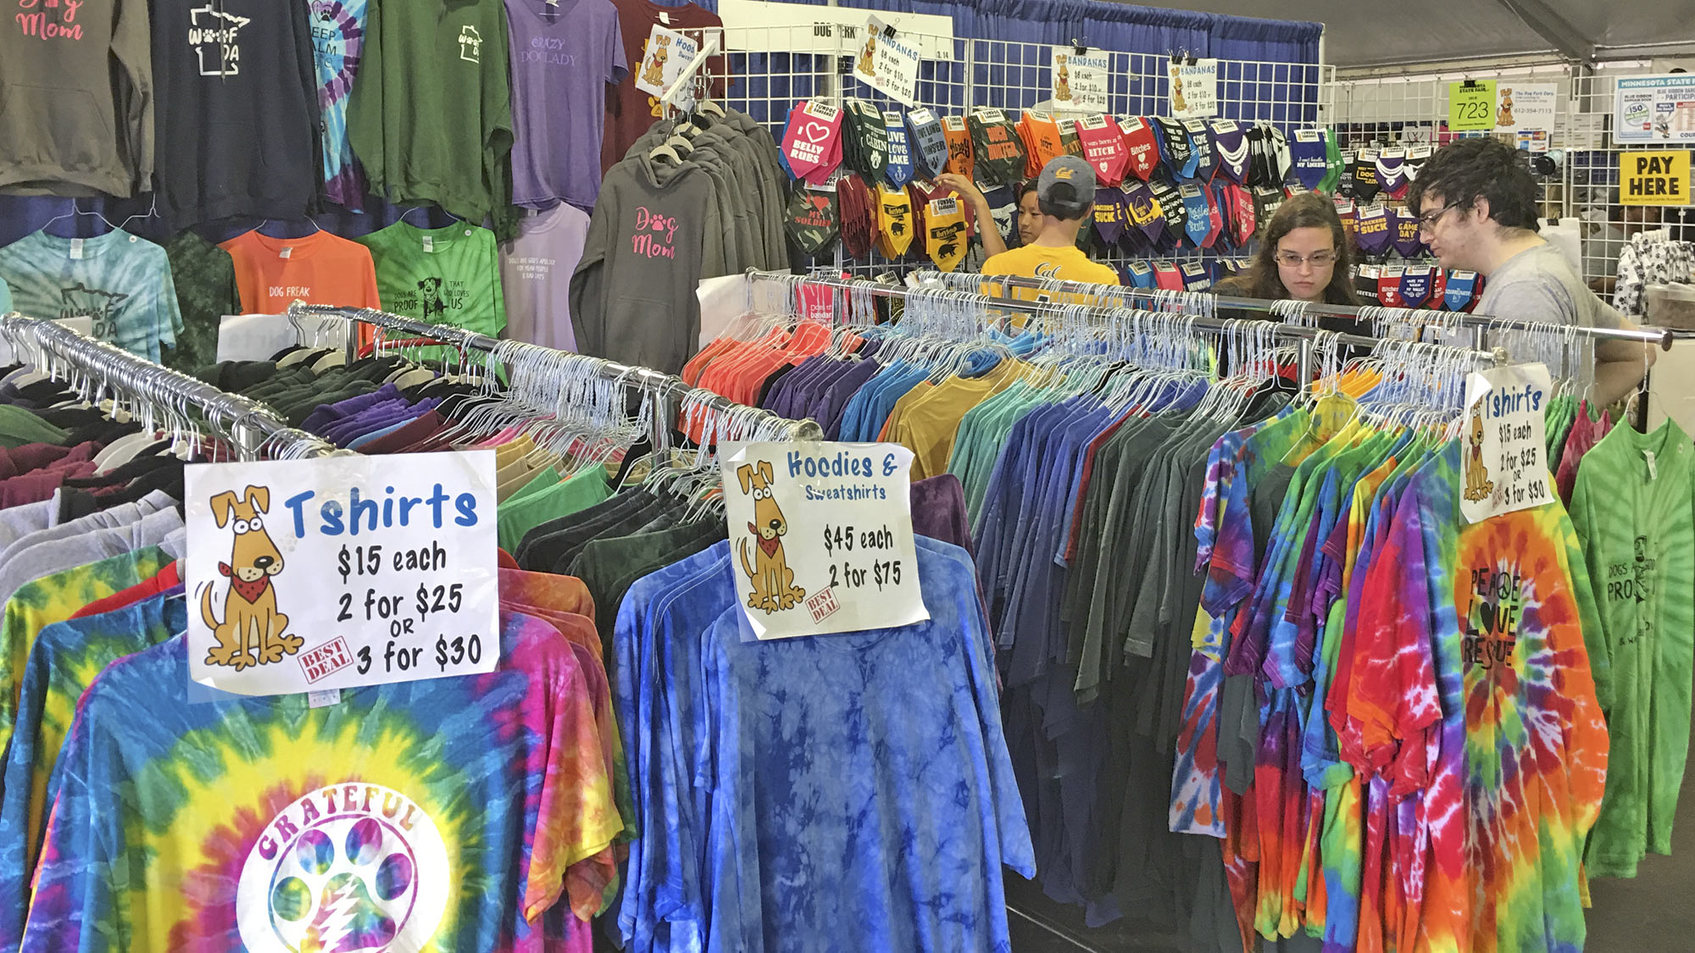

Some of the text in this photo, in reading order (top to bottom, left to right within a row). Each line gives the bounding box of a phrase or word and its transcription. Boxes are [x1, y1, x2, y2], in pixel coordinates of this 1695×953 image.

[15, 12, 83, 40] Mom
[311, 26, 336, 40] EEP
[814, 22, 832, 37] DOG
[878, 31, 918, 62] BANDANAS
[888, 56, 900, 67] each
[1068, 56, 1106, 68] BANDANAS
[878, 62, 883, 70] 2
[884, 64, 892, 75] for
[894, 68, 903, 82] $10
[1180, 66, 1216, 76] BANDANAS
[886, 78, 890, 87] 5
[892, 80, 900, 92] for
[901, 86, 912, 98] $20
[1082, 94, 1086, 103] 5
[1088, 94, 1096, 104] for
[1456, 102, 1488, 120] 723
[797, 126, 804, 135] I
[887, 131, 906, 144] LIVE
[792, 139, 824, 155] BELLY
[866, 134, 888, 152] CABIN
[1088, 146, 1116, 157] BITCH
[1130, 143, 1152, 156] Bitches
[790, 148, 820, 164] RUBS
[889, 154, 910, 165] LAKE
[1636, 156, 1674, 174] PAY
[1055, 167, 1074, 180] Cal
[1138, 162, 1149, 172] Me
[1630, 177, 1680, 195] HERE
[794, 216, 832, 227] SOLDIER
[808, 210, 820, 219] MY
[1094, 212, 1116, 222] SUCK
[635, 206, 679, 244] Dog
[1360, 222, 1388, 234] SUCK
[1398, 223, 1418, 231] GAME
[632, 234, 676, 260] Mom
[1034, 262, 1062, 279] Cal
[269, 286, 310, 297] DOG FREAK
[394, 300, 418, 312] PROOF
[451, 298, 463, 310] US
[1486, 384, 1543, 419] Tshirts
[1499, 420, 1532, 448] $15 each
[787, 451, 898, 479] Hoodies &
[1500, 448, 1537, 472] 2 for $25
[1513, 470, 1522, 482] OR
[806, 484, 886, 501] Sweatshirts
[1504, 486, 1509, 506] 3
[1512, 483, 1526, 505] for
[1528, 480, 1545, 504] $30
[284, 484, 478, 538] Tshirts
[824, 524, 893, 557] $45 each
[338, 540, 446, 584] $15 each
[1609, 562, 1628, 578] DOGS
[829, 559, 901, 592] 2 for $75
[808, 588, 831, 610] BEST
[1608, 580, 1632, 602] PRO
[337, 582, 463, 622] 2 for $25
[813, 600, 838, 621] DEAL
[391, 618, 414, 637] OR
[302, 640, 342, 668] BEST
[356, 634, 481, 675] 3 for $30
[1463, 637, 1515, 670] RESUE
[307, 653, 350, 680] DEAL
[258, 785, 416, 860] GRATEFUL
